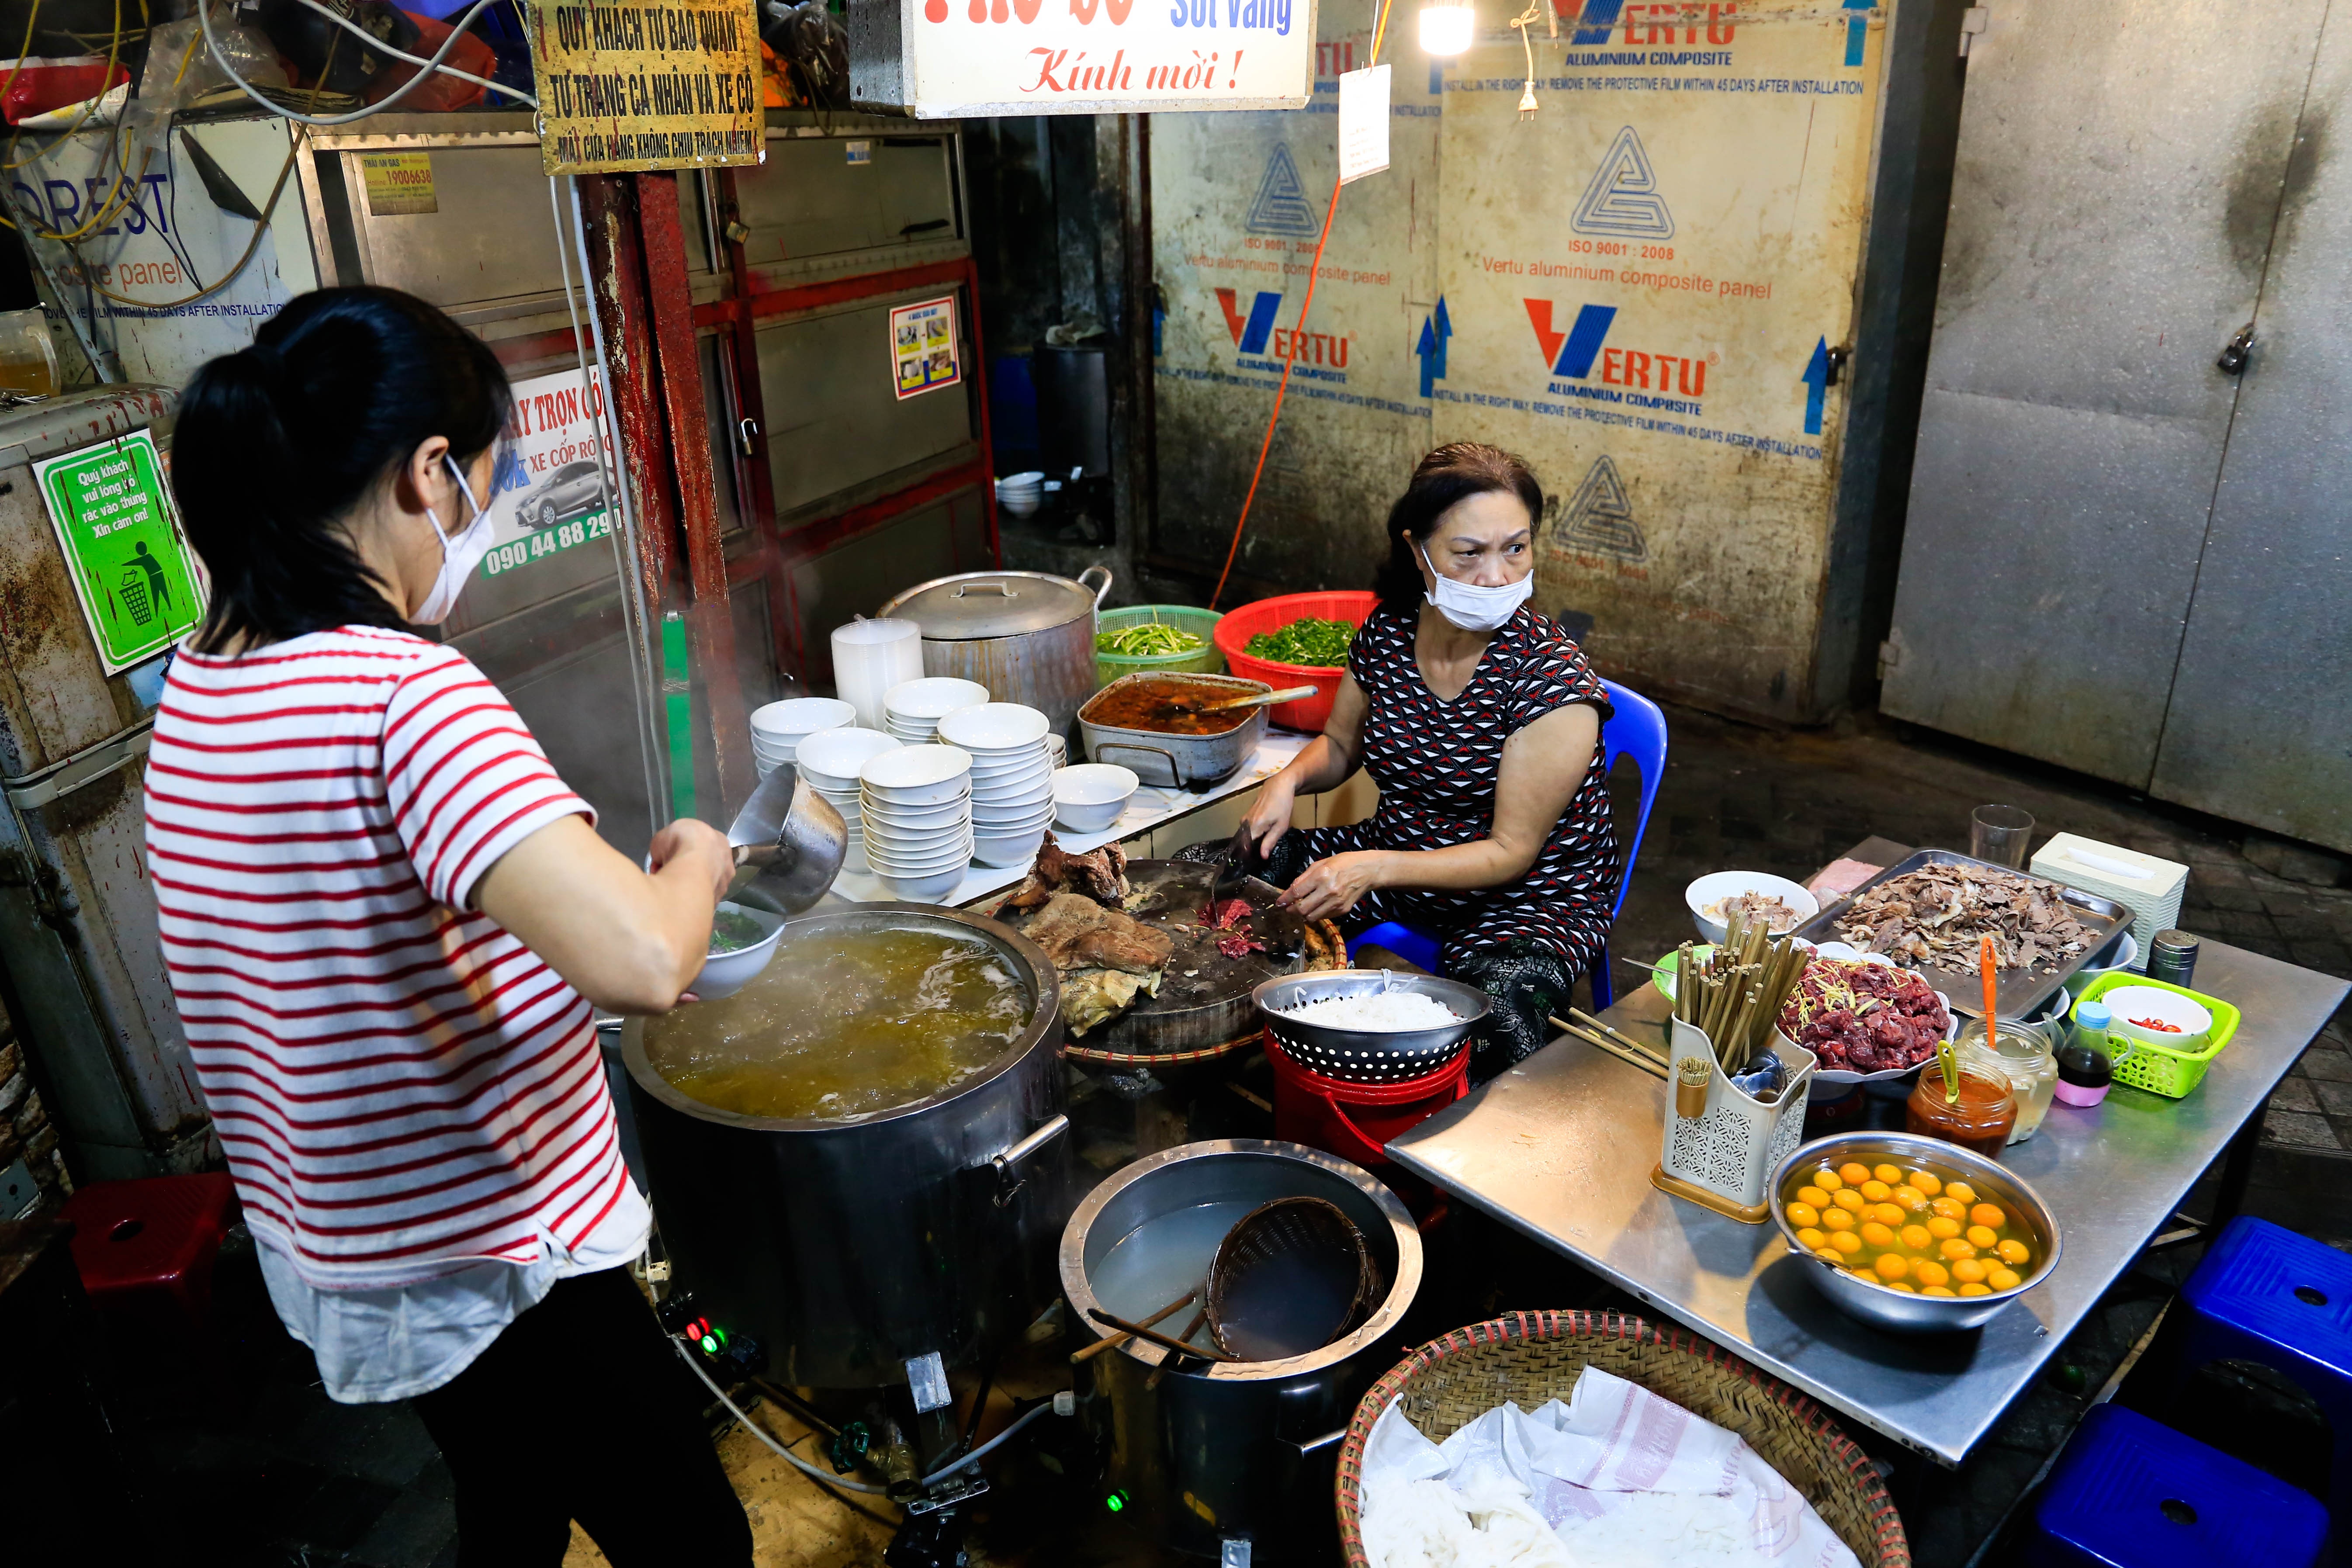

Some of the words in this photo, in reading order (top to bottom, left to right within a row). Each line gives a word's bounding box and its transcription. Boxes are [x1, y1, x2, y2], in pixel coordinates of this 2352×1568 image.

[644, 5, 665, 60] TỰ
[1019, 47, 1134, 92] Kính
[1146, 50, 1218, 89] mời
[1229, 49, 1244, 89] !
[1566, 52, 1646, 66] ALUMINIUM
[1650, 52, 1732, 66] COMPOSITE
[573, 74, 627, 117] TRANG
[629, 65, 651, 116] CÁ
[651, 65, 693, 115] NHÂN
[694, 65, 714, 114] VÀ
[716, 74, 734, 114] XE
[737, 65, 754, 122] CỘ
[1550, 77, 1584, 90] REMOVE
[1587, 77, 1601, 90] THE
[1605, 77, 1658, 91] PROTECTIVE
[1660, 77, 1680, 91] FILM
[1683, 77, 1715, 91] WITHIN
[1717, 78, 1728, 91] 45
[1731, 79, 1756, 92] DAYS
[1758, 79, 1789, 93] AFTER
[1793, 80, 1864, 94] INSTALLATION
[636, 128, 669, 159] KHÔNG
[672, 132, 693, 163] CHỊU
[695, 126, 724, 156] TRÁCH
[725, 125, 752, 159] NHIỆM
[386, 170, 432, 185] 19006638
[388, 158, 400, 167] GAS
[1244, 237, 1261, 249] ISO
[1568, 240, 1592, 253] ISO
[1597, 242, 1628, 256] 9001
[1641, 246, 1674, 260] 2008
[118, 255, 183, 292] panel
[1218, 255, 1278, 273] aluminium
[1283, 262, 1349, 281] comosite
[1353, 270, 1391, 286] panel
[1482, 256, 1523, 274] Vertu
[1529, 261, 1614, 283] aluminium
[1620, 269, 1714, 293] composite
[1719, 280, 1772, 299] panel
[113, 306, 144, 318] WITHIN
[147, 307, 158, 318] 45
[160, 307, 185, 318] DAYS
[188, 305, 218, 317] AFTER
[221, 304, 286, 316] INSTALLATIO
[1523, 298, 1706, 397] VERTU
[535, 388, 578, 435] TRỌN
[1548, 382, 1622, 403] ALUMINIUM
[1626, 393, 1702, 415] COMPOSITE
[1533, 402, 1566, 417] REMOVE
[1567, 406, 1582, 419] THE
[1584, 408, 1634, 427] PROTECTIVE
[1636, 417, 1654, 430] FILM
[1657, 420, 1686, 436] WITHIN
[1687, 427, 1698, 438] 45
[1699, 428, 1723, 443] DAYS
[1756, 438, 1822, 460] INSTALLATION
[530, 453, 546, 473] XE
[550, 438, 576, 467] CỐP
[78, 468, 101, 486] Quý
[100, 460, 128, 478] khách
[82, 488, 99, 503] vui
[99, 482, 122, 498] lòng
[82, 509, 99, 523] rác
[100, 502, 119, 516] vào
[120, 492, 148, 509] thùng
[92, 523, 111, 538] Xin
[486, 541, 528, 575] 090
[531, 534, 556, 557] 44
[558, 523, 585, 549] 88
